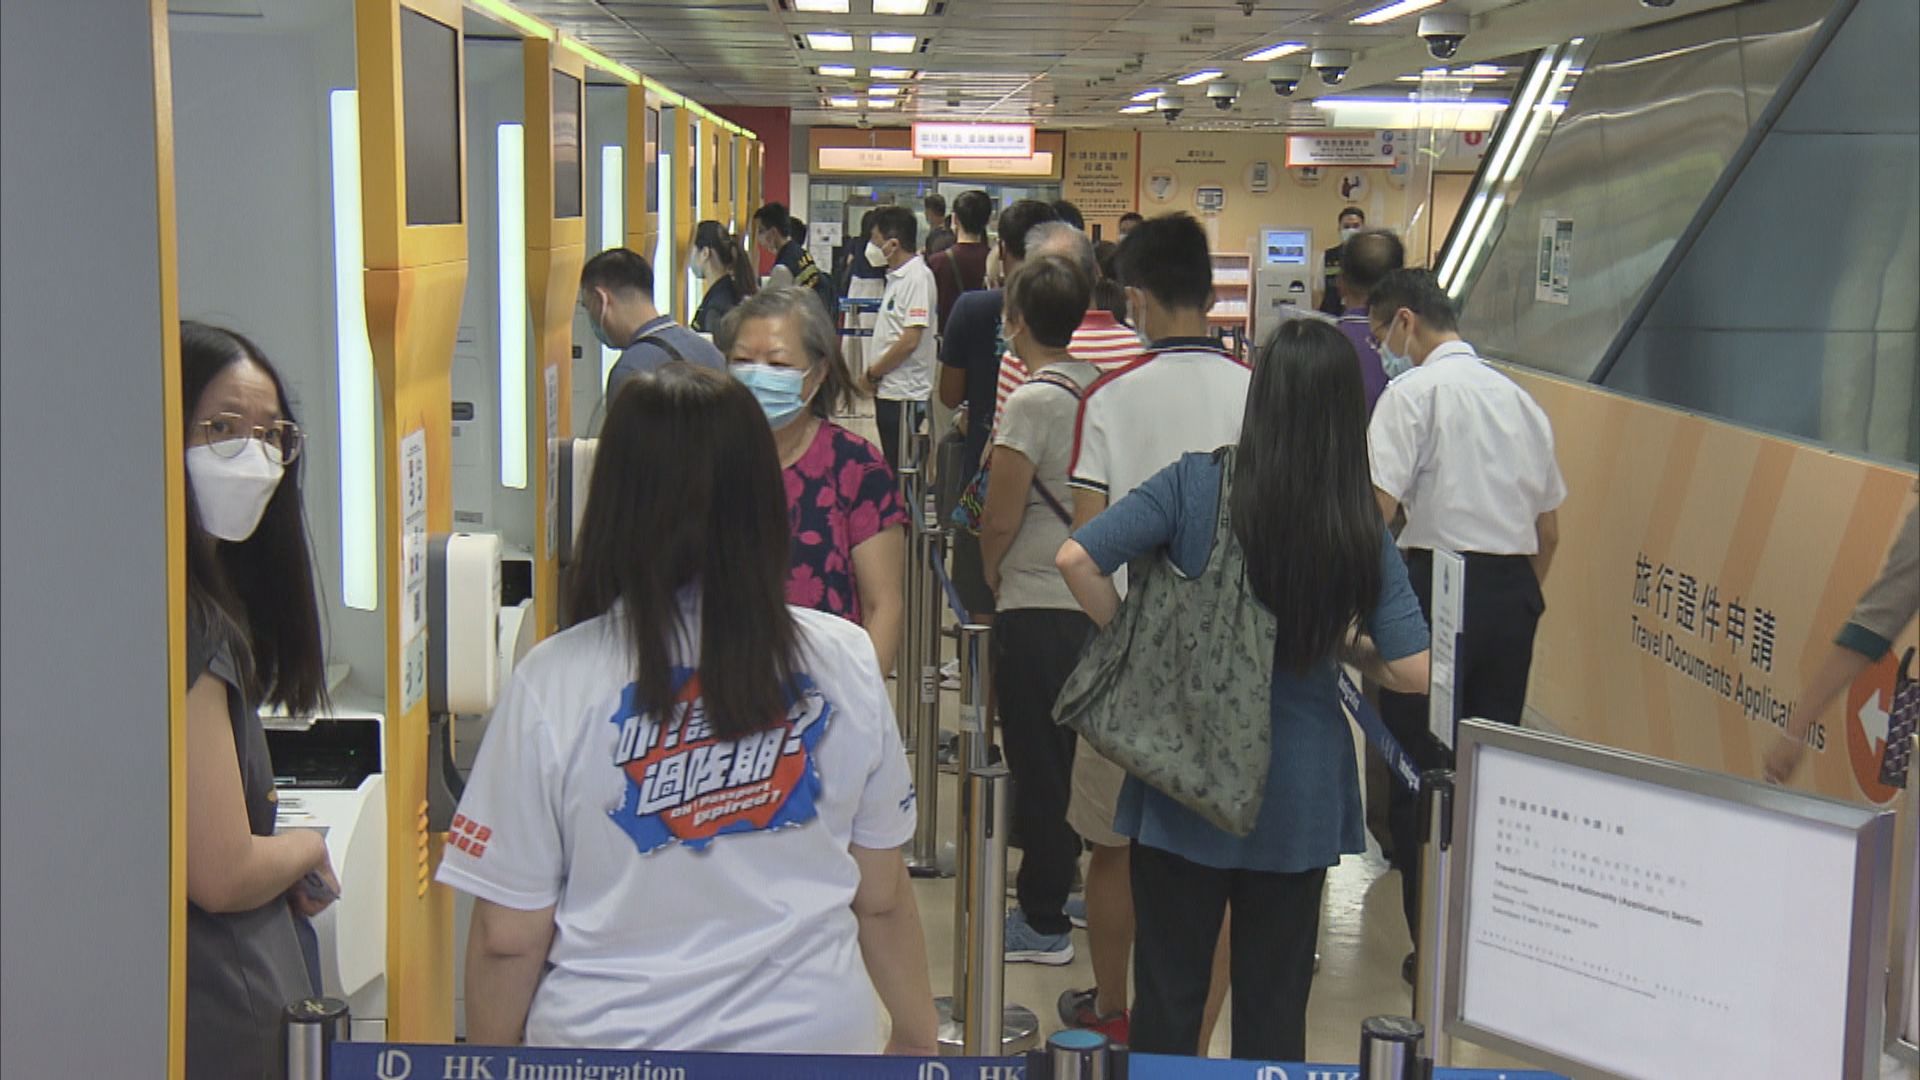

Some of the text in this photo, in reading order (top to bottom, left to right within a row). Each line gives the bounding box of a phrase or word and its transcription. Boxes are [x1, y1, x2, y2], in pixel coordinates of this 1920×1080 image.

[1633, 551, 1776, 672] 旅行證件申請
[1631, 614, 1826, 752] Travel Documents Applicatns
[442, 1055, 494, 1080] HK
[506, 1057, 687, 1080] Immigration
